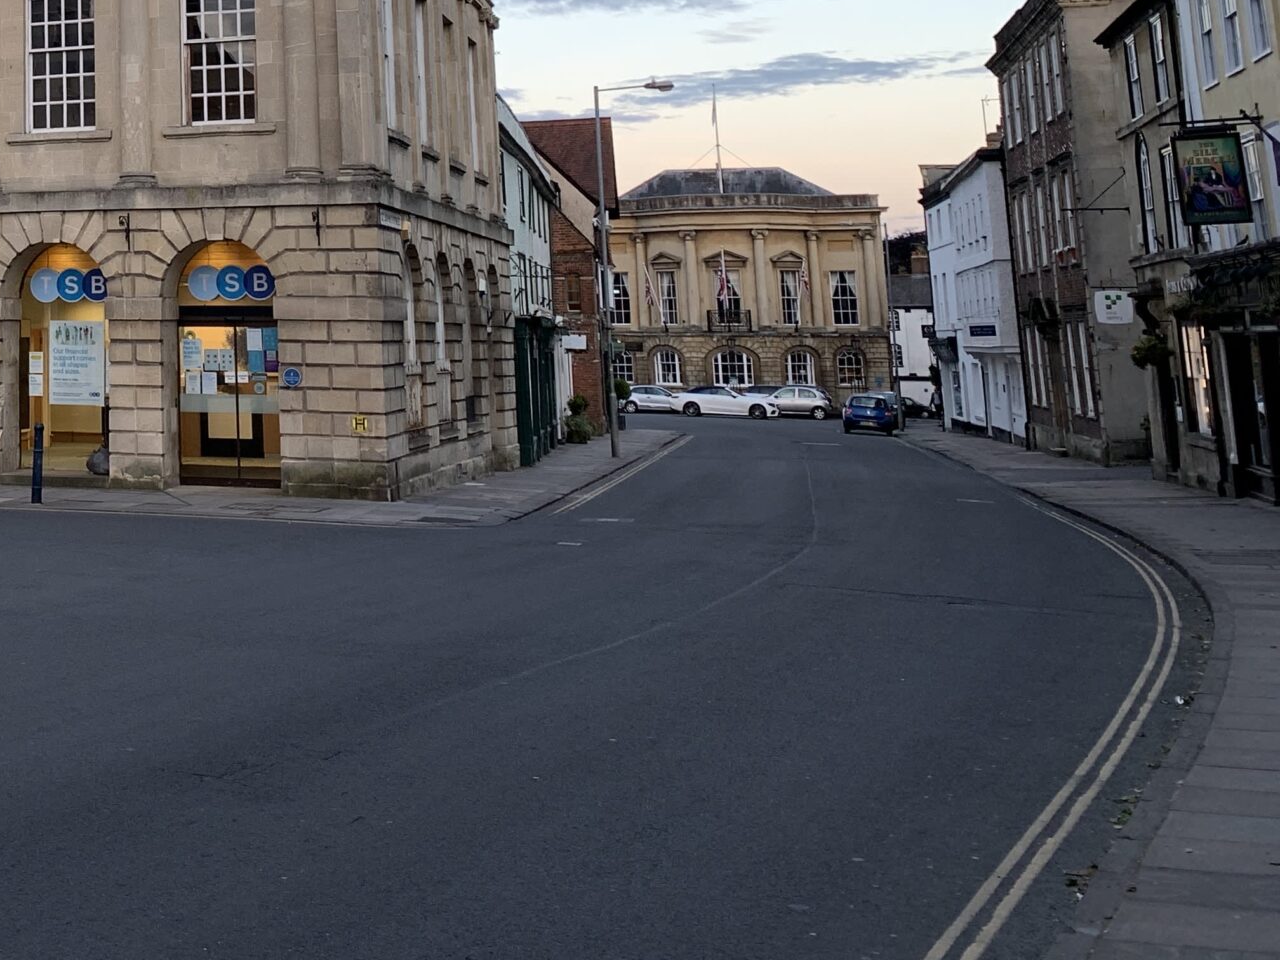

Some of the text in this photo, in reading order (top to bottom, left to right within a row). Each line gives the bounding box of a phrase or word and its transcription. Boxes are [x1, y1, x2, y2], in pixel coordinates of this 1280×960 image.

[1193, 148, 1217, 157] SILK
[41, 276, 106, 295] TSB
[198, 272, 269, 293] TSB
